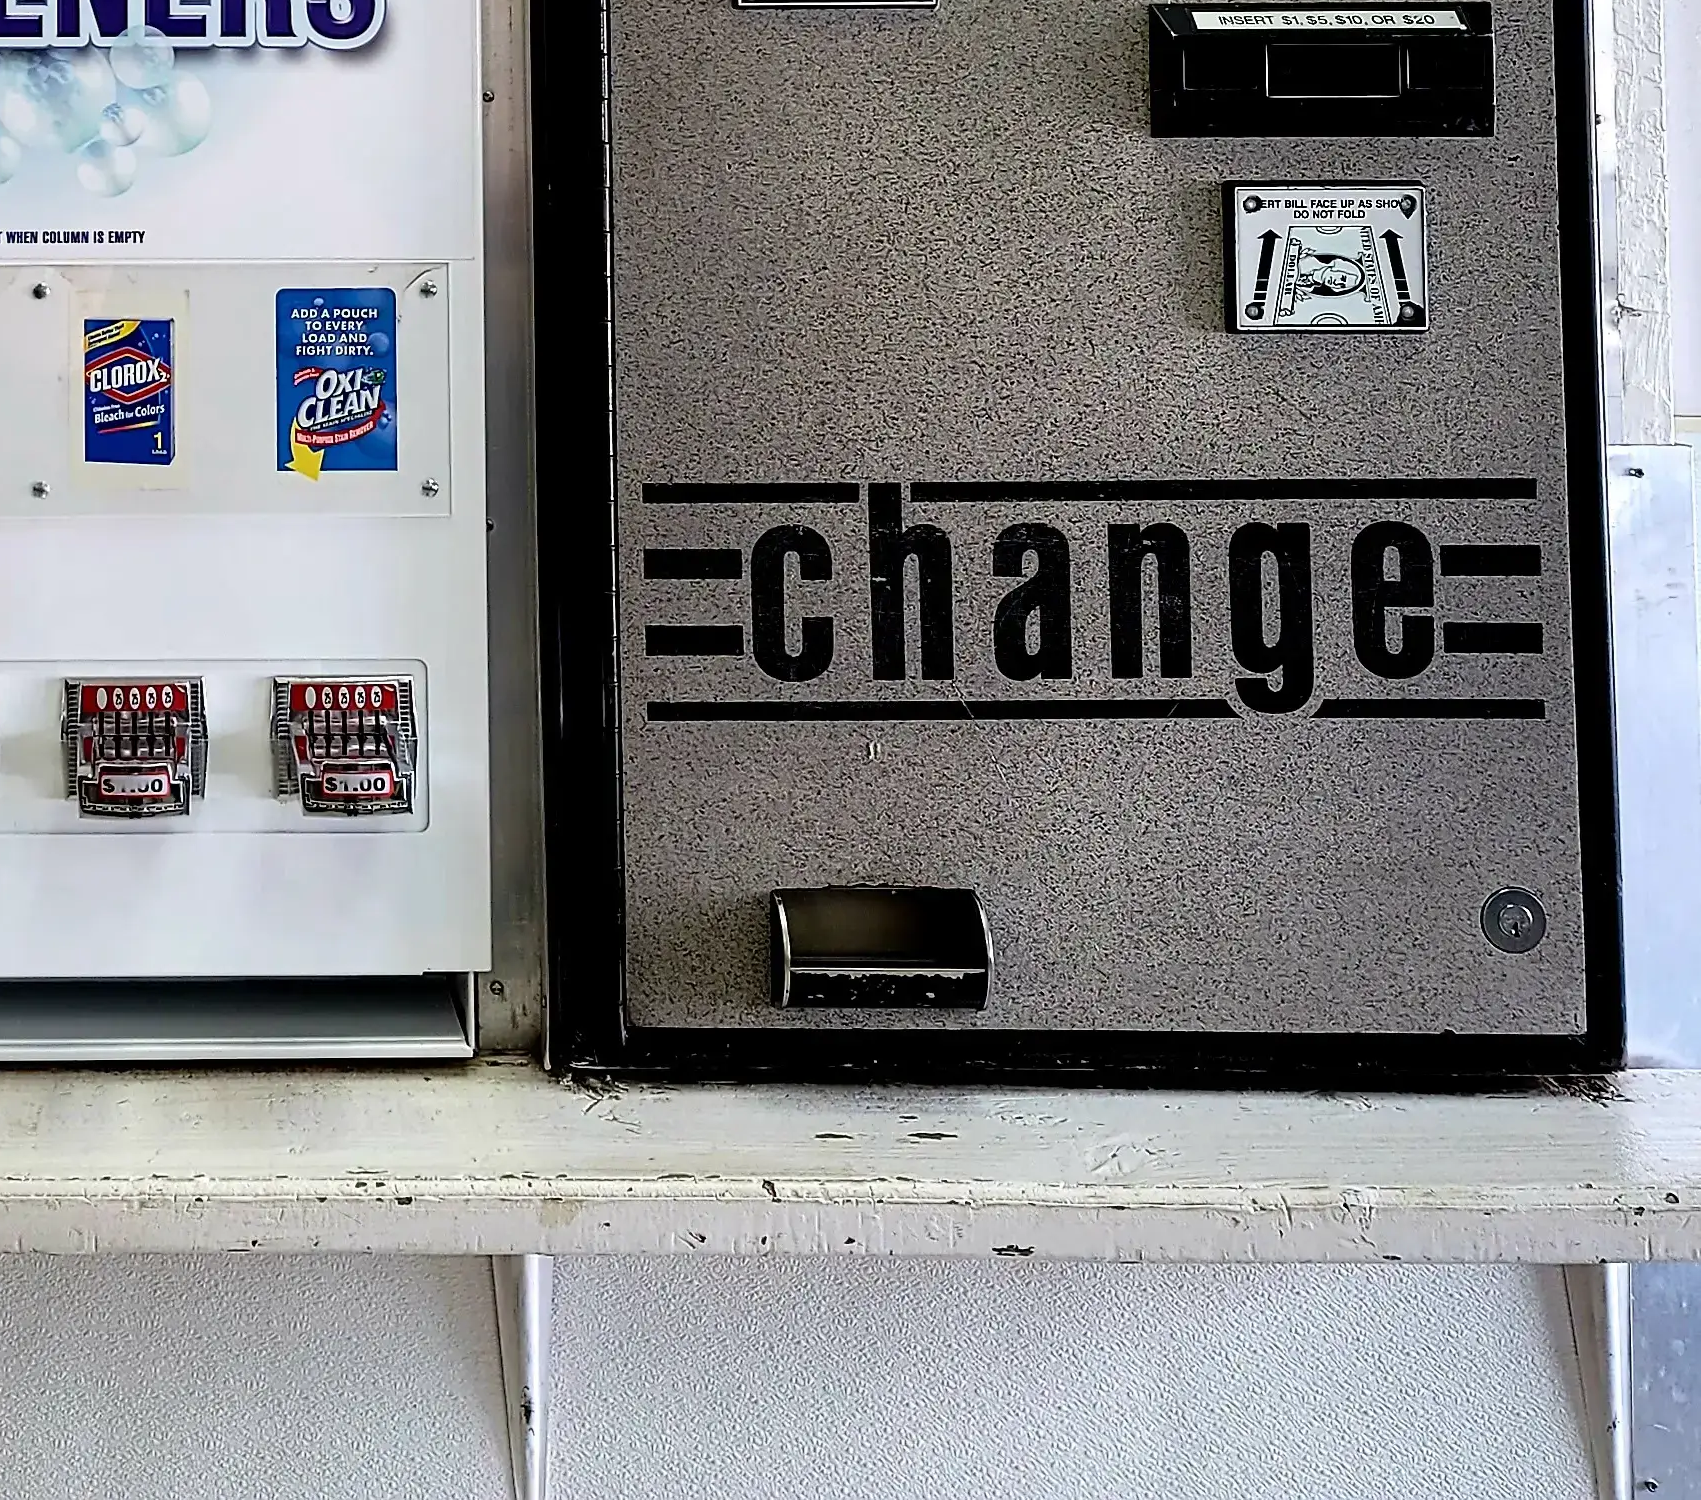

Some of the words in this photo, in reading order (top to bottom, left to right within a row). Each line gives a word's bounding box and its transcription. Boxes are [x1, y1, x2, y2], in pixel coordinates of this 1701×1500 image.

[1218, 15, 1275, 26] INSERT
[1371, 15, 1396, 25] OR
[1402, 15, 1435, 25] $20
[1284, 200, 1308, 209] BILL
[1310, 200, 1337, 209] FACE
[1341, 200, 1355, 209] UP
[1359, 200, 1373, 209] AS
[1293, 210, 1310, 219] DO
[1313, 210, 1336, 219] NOT
[1338, 210, 1366, 219] FOLD
[6, 231, 38, 245] WHEN
[42, 231, 89, 245] COLUMN
[93, 231, 104, 245] IS
[108, 231, 146, 245] EMPTY
[291, 308, 318, 319] ADD
[321, 309, 330, 318] A
[333, 308, 378, 319] POUCH
[305, 321, 322, 331] TO
[325, 320, 364, 331] EVERY
[302, 333, 336, 343] LOAD
[339, 333, 367, 343] AND
[296, 345, 333, 356] FIGHT
[335, 345, 374, 356] DIRTY.
[315, 368, 364, 400] OXI
[297, 385, 381, 428] CLEAN
[94, 409, 125, 424] Bleach
[125, 411, 134, 419] for
[135, 404, 165, 417] Colors
[153, 431, 162, 449] 1
[751, 482, 1435, 715] change
[324, 777, 386, 792] $1.00
